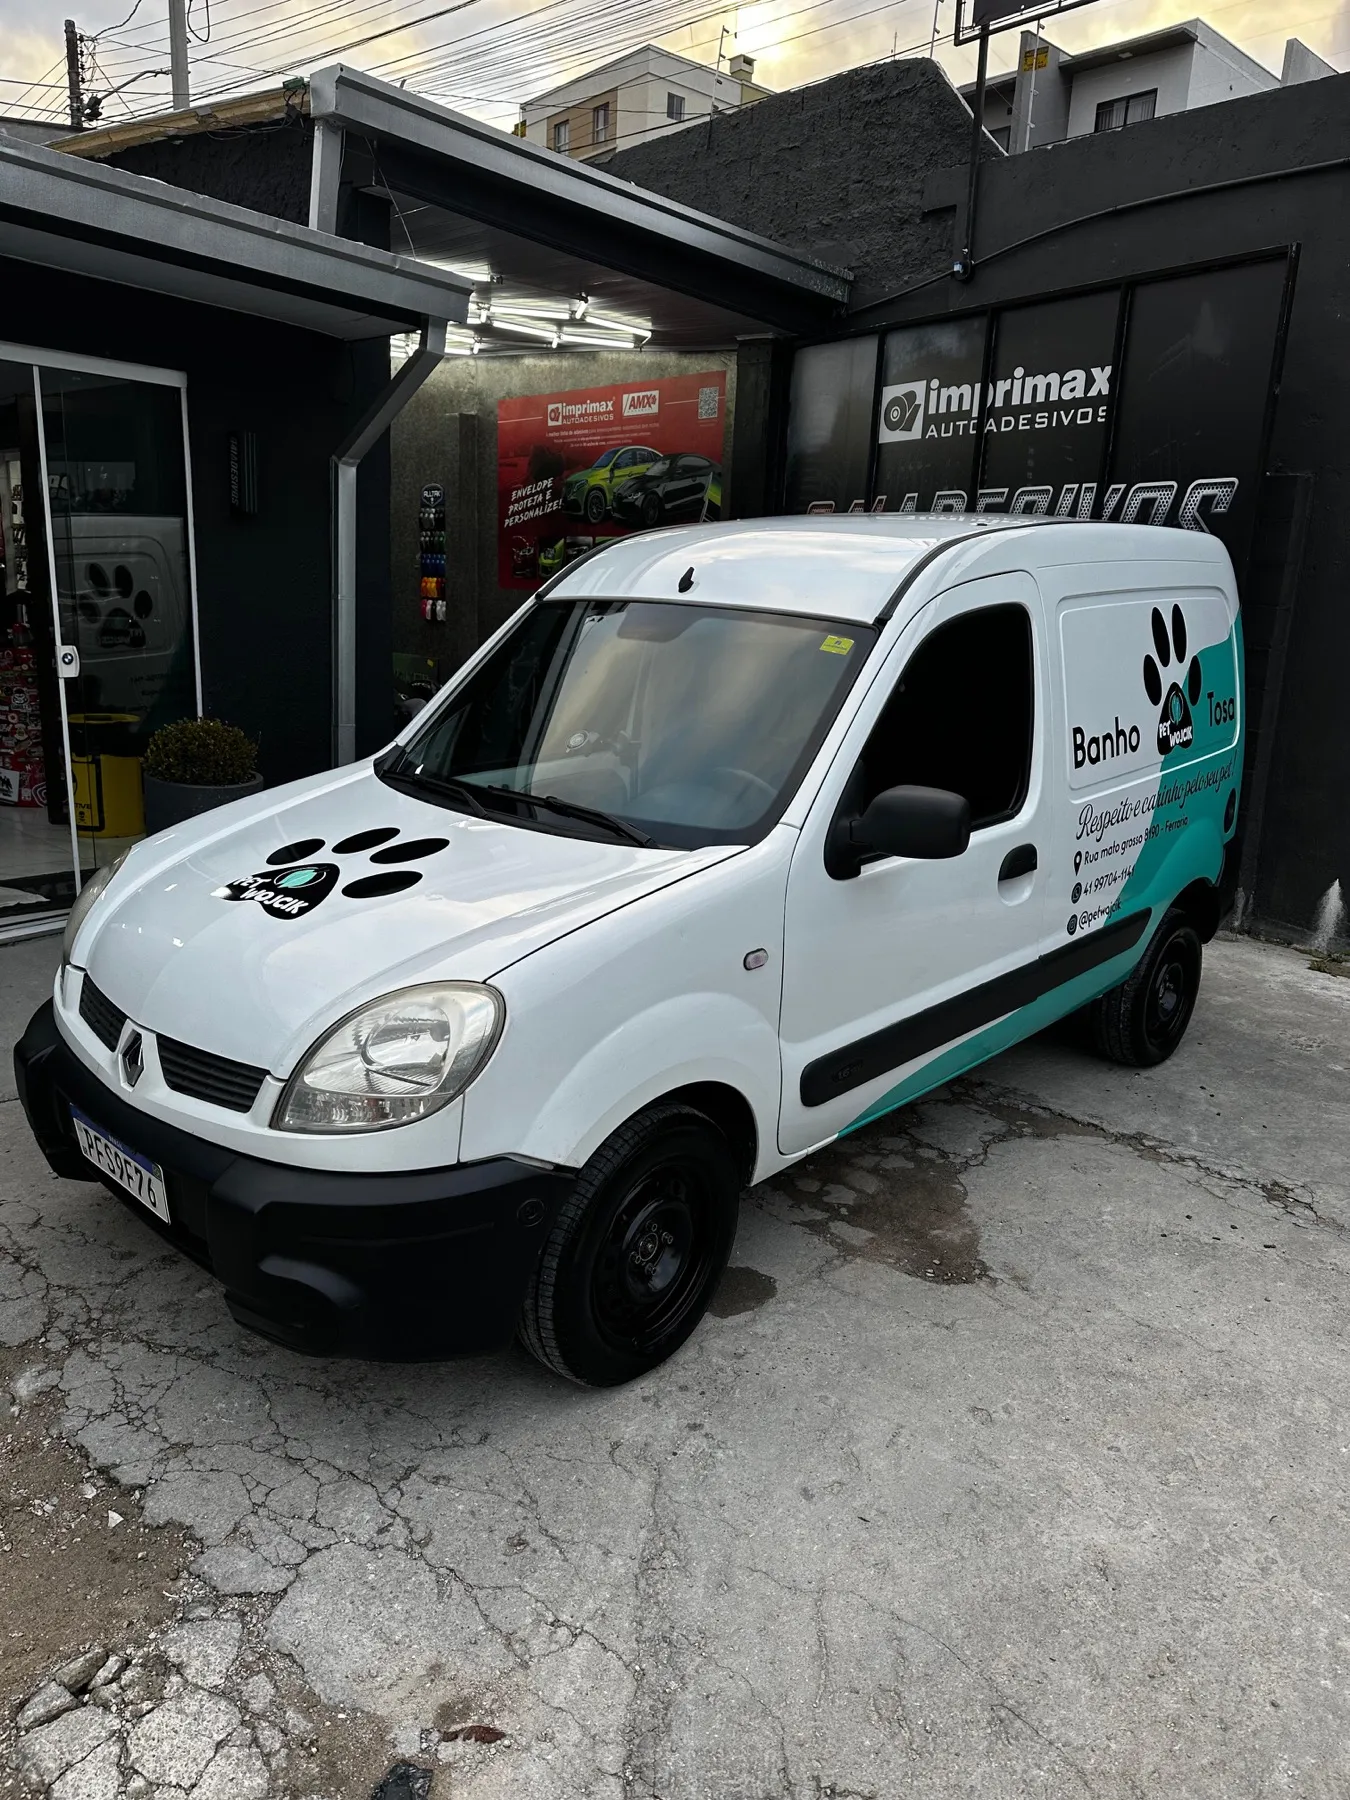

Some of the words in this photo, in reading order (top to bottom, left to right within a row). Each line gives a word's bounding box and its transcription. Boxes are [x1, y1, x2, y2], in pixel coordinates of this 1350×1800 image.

[629, 394, 653, 410] AMX
[929, 366, 1112, 417] imprimax
[562, 414, 614, 425] AUTOADESIVOS
[563, 400, 614, 417] imprimax
[926, 406, 1107, 439] AUTOADESIVOS
[508, 493, 543, 516] PROTEJA
[545, 489, 553, 500] E
[511, 477, 554, 501] ENVELOPE
[1207, 691, 1235, 727] Tosa
[1072, 716, 1141, 769] Banho
[1159, 720, 1171, 739] PET
[1076, 797, 1134, 842] Respeito
[1133, 801, 1141, 817] e
[1141, 778, 1184, 814] carinho
[1084, 850, 1099, 865] Rua
[1100, 840, 1120, 859] mato
[1144, 824, 1160, 842] 8190
[232, 874, 272, 889] PET
[1083, 880, 1093, 896] 41
[239, 886, 309, 914] WOJCIK
[82, 1126, 157, 1209] PFS9F76
